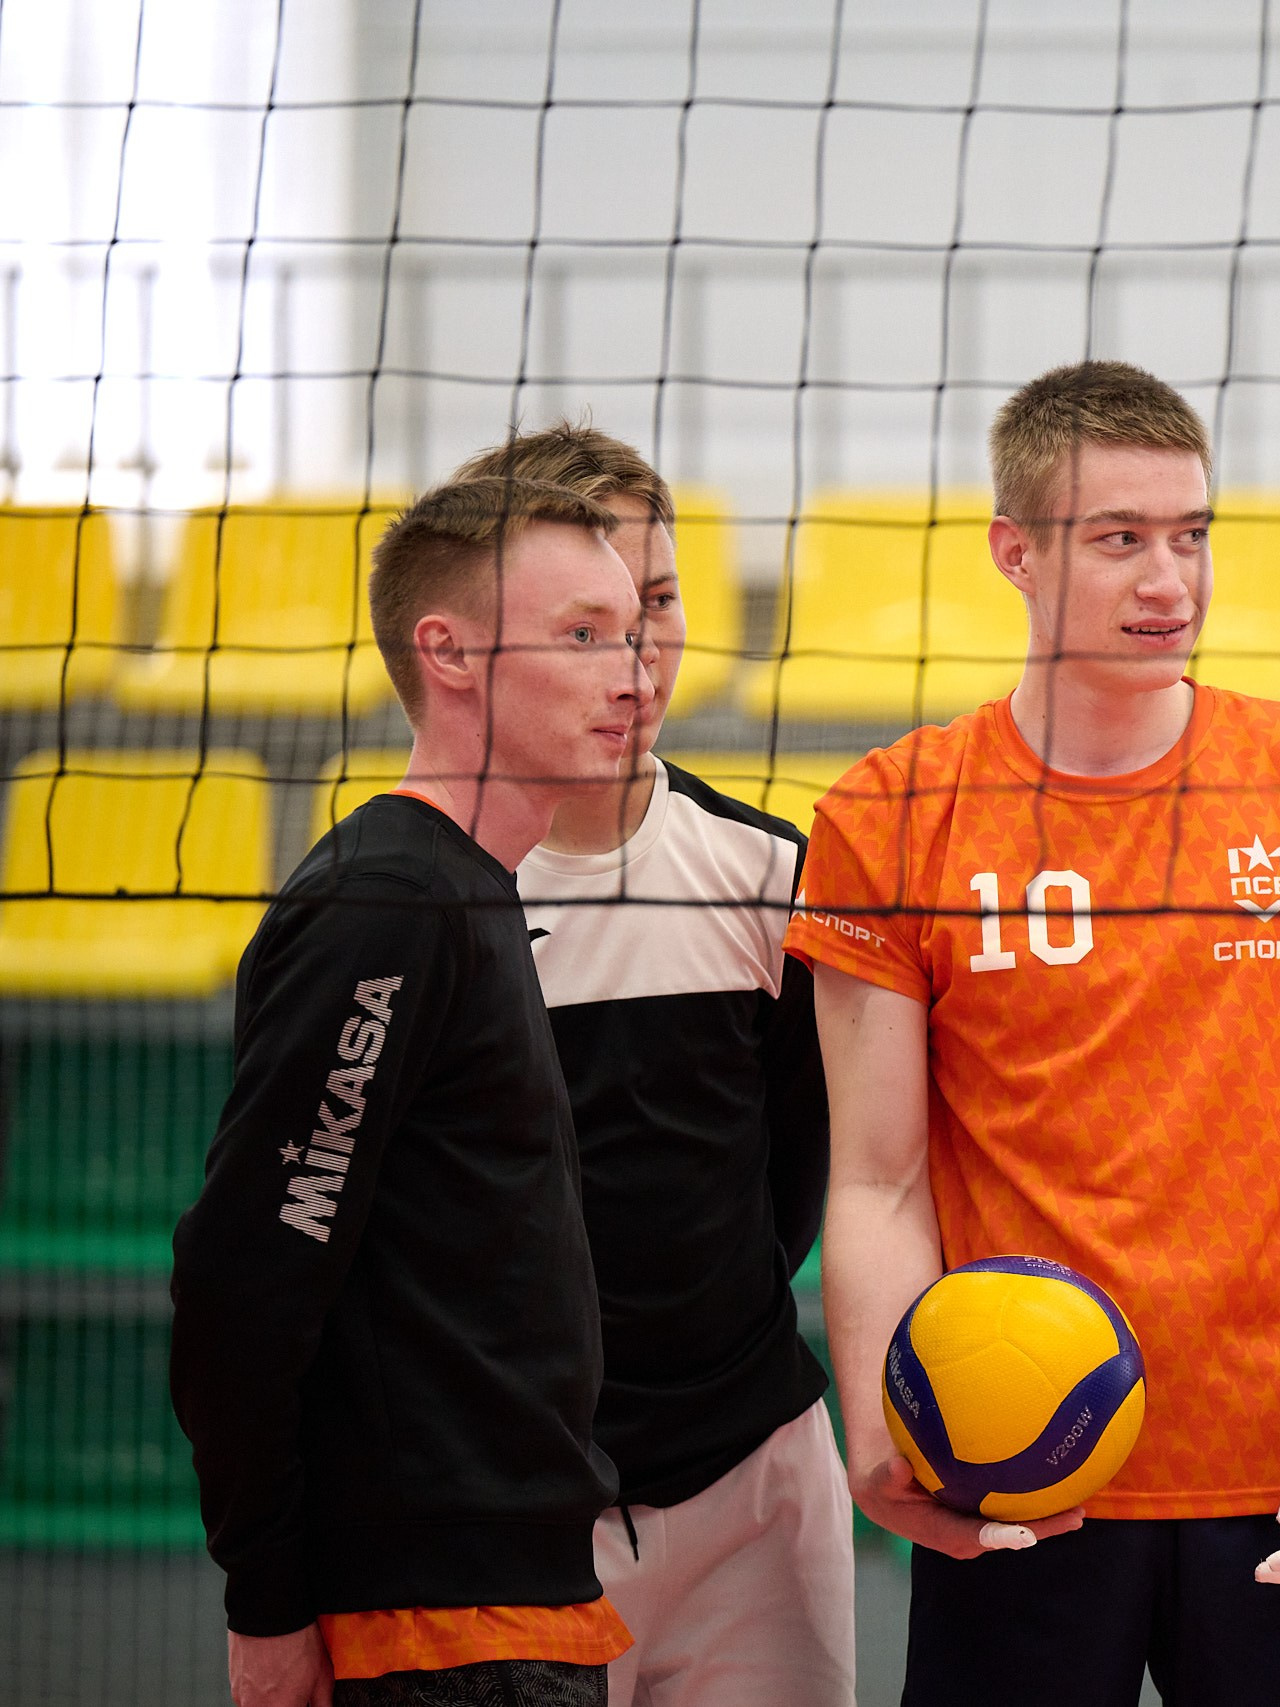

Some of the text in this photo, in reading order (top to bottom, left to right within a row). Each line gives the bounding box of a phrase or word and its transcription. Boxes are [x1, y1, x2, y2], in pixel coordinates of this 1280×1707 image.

[811, 907, 886, 948] СПОРТ
[969, 869, 1095, 974] 10
[1046, 1404, 1094, 1466] V200W
